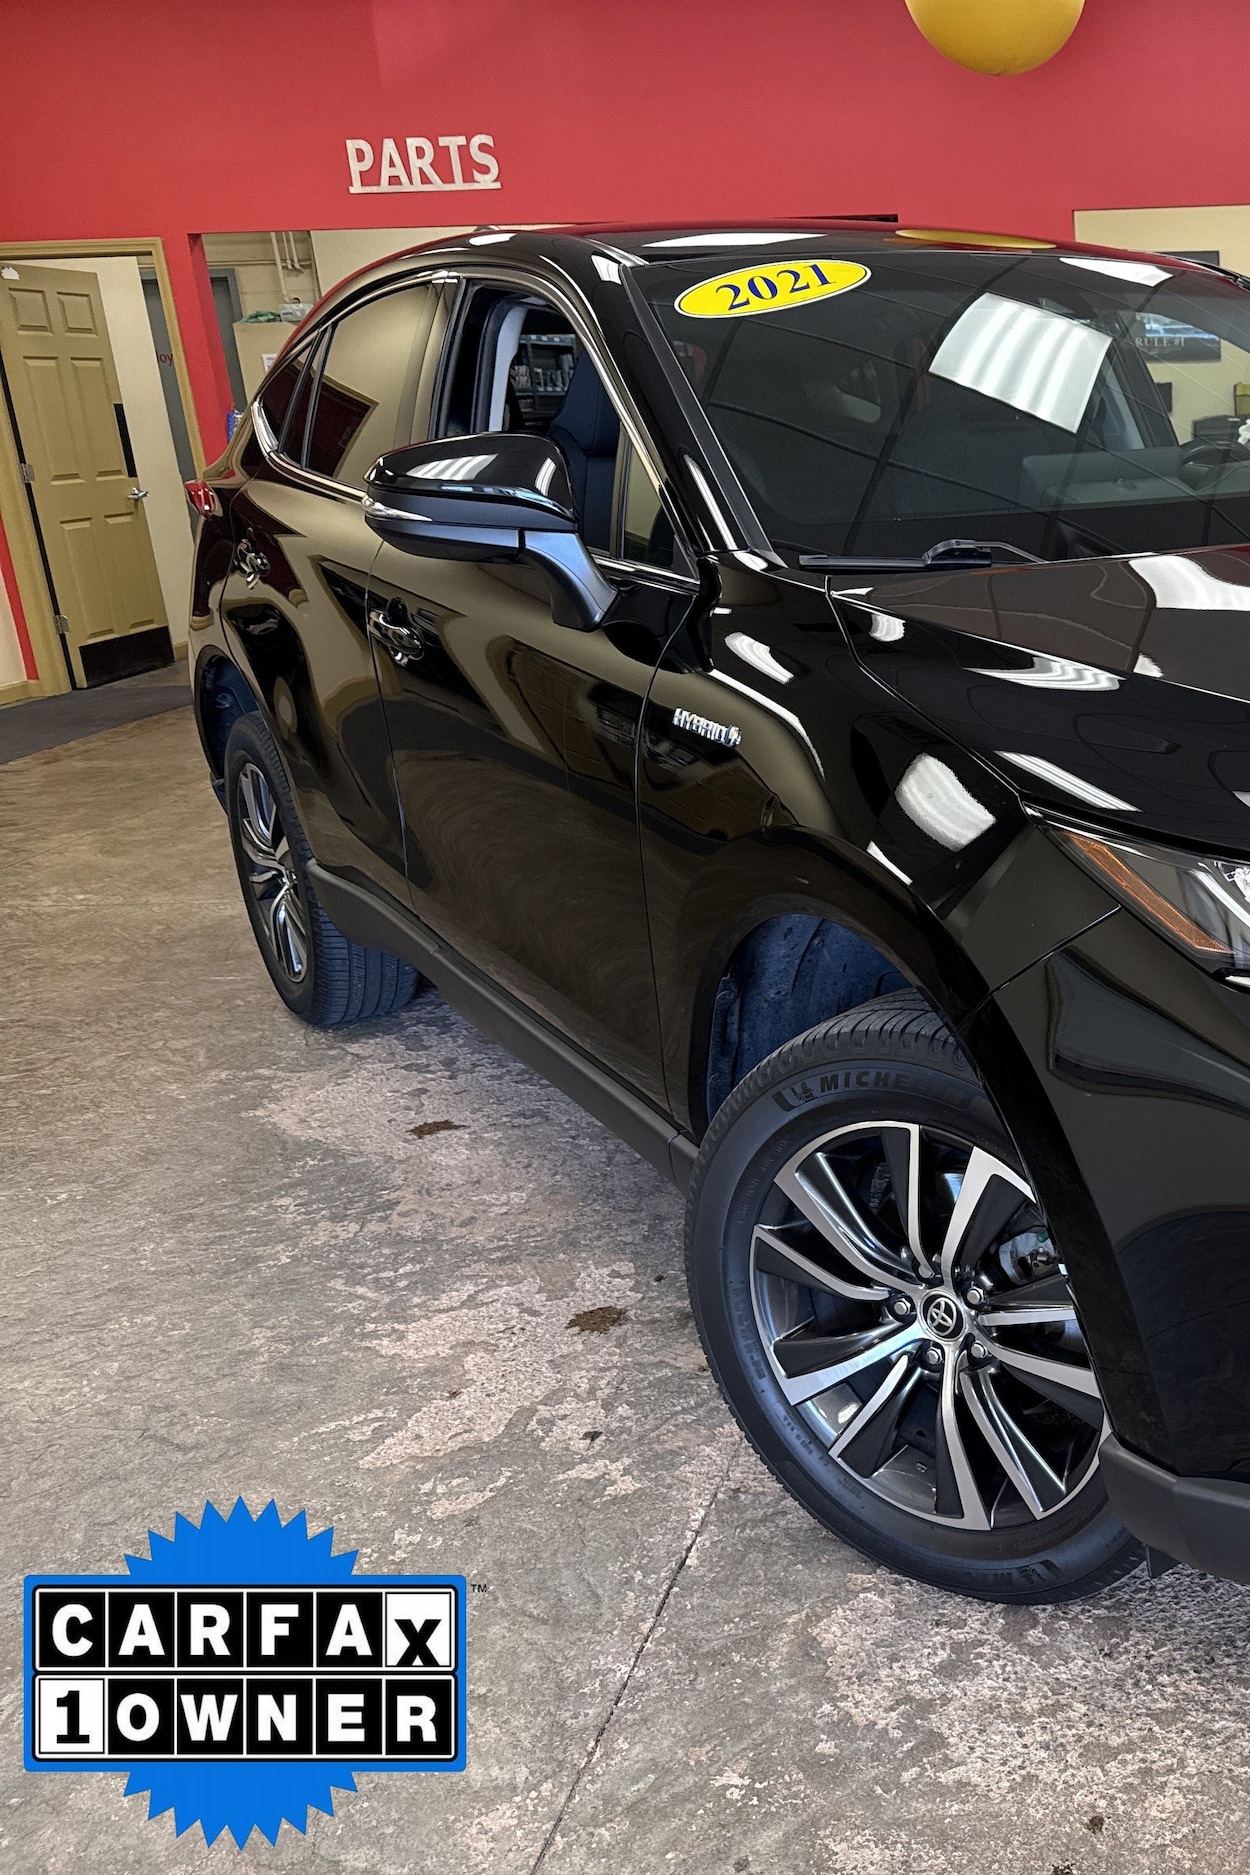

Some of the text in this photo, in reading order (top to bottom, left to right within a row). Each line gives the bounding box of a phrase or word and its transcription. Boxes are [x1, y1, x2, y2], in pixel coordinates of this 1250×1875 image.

[346, 134, 500, 189] PARTS
[715, 263, 836, 311] 2021
[1135, 338, 1170, 347] RULE
[673, 708, 728, 743] HYBRID
